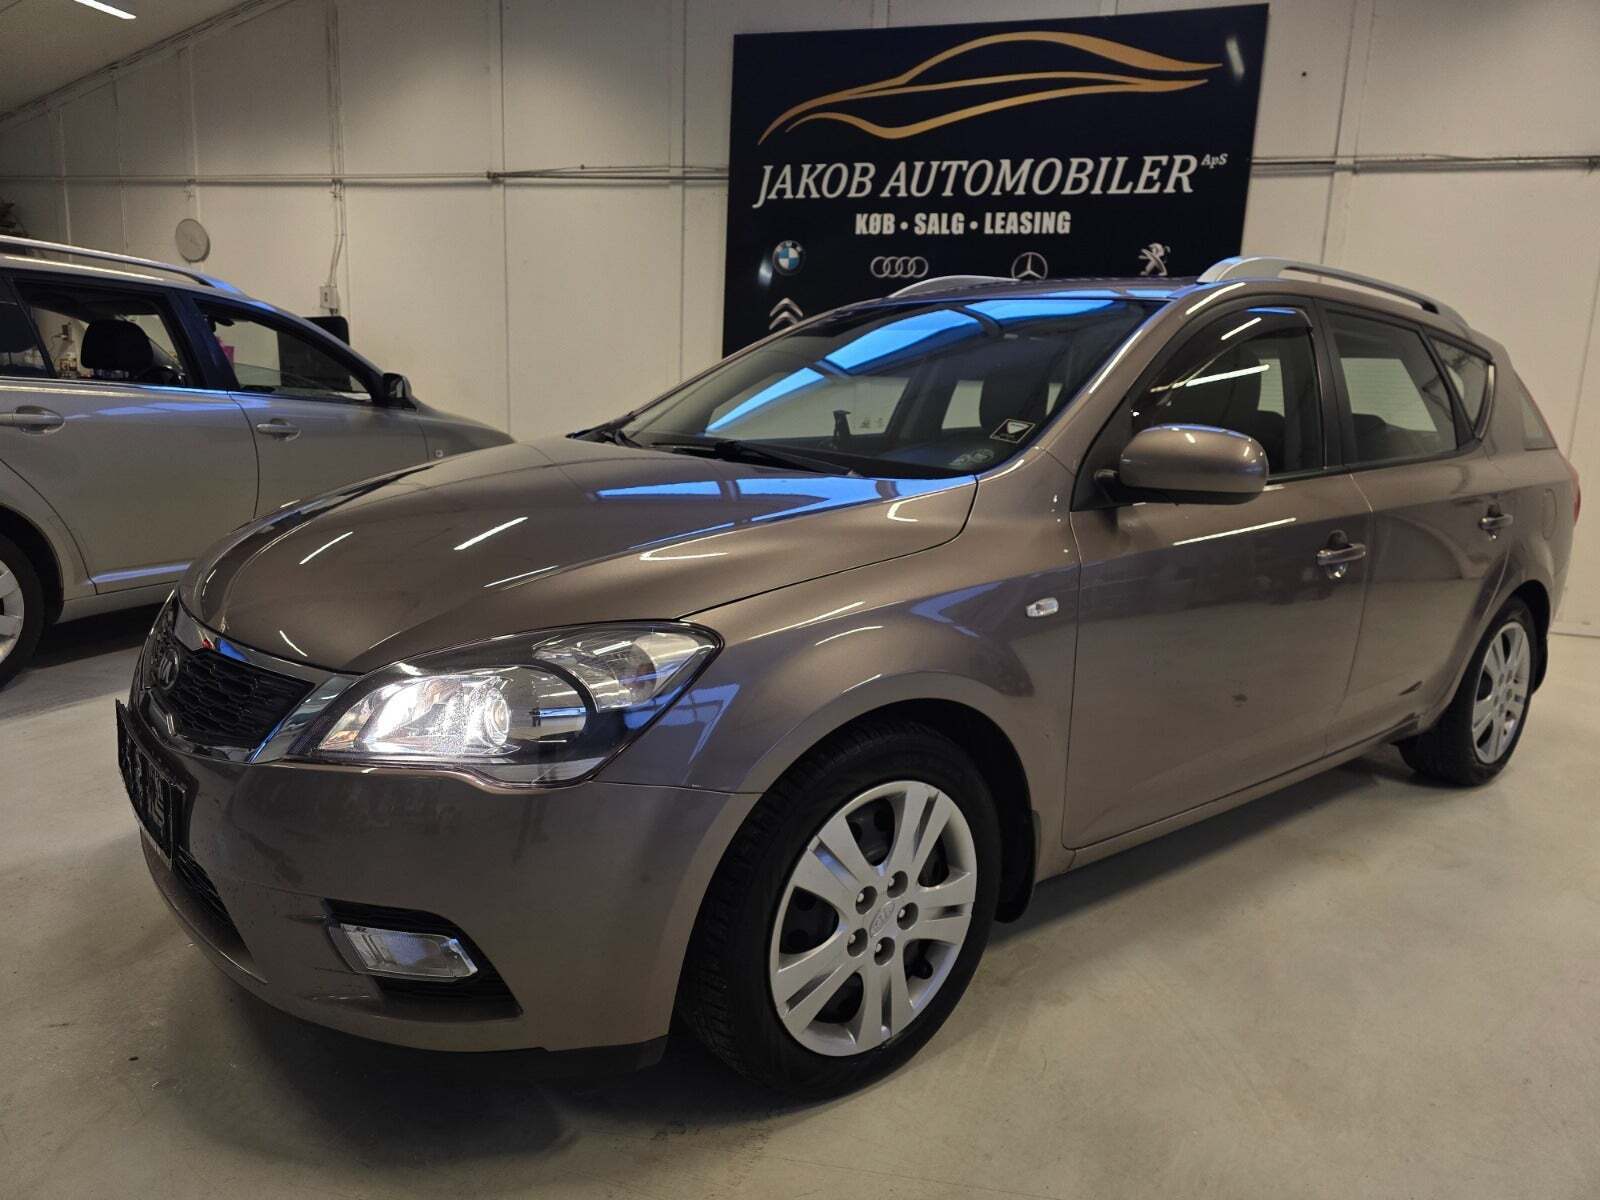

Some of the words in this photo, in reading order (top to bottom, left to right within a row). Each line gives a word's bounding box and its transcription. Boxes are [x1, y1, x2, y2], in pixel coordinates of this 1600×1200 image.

[752, 163, 875, 208] JAKOB
[880, 155, 1197, 197] AUTOMOBILER
[1201, 154, 1228, 168] ApS
[855, 213, 895, 235] KØB
[914, 213, 964, 235] SALG
[984, 211, 1071, 234] LEASING
